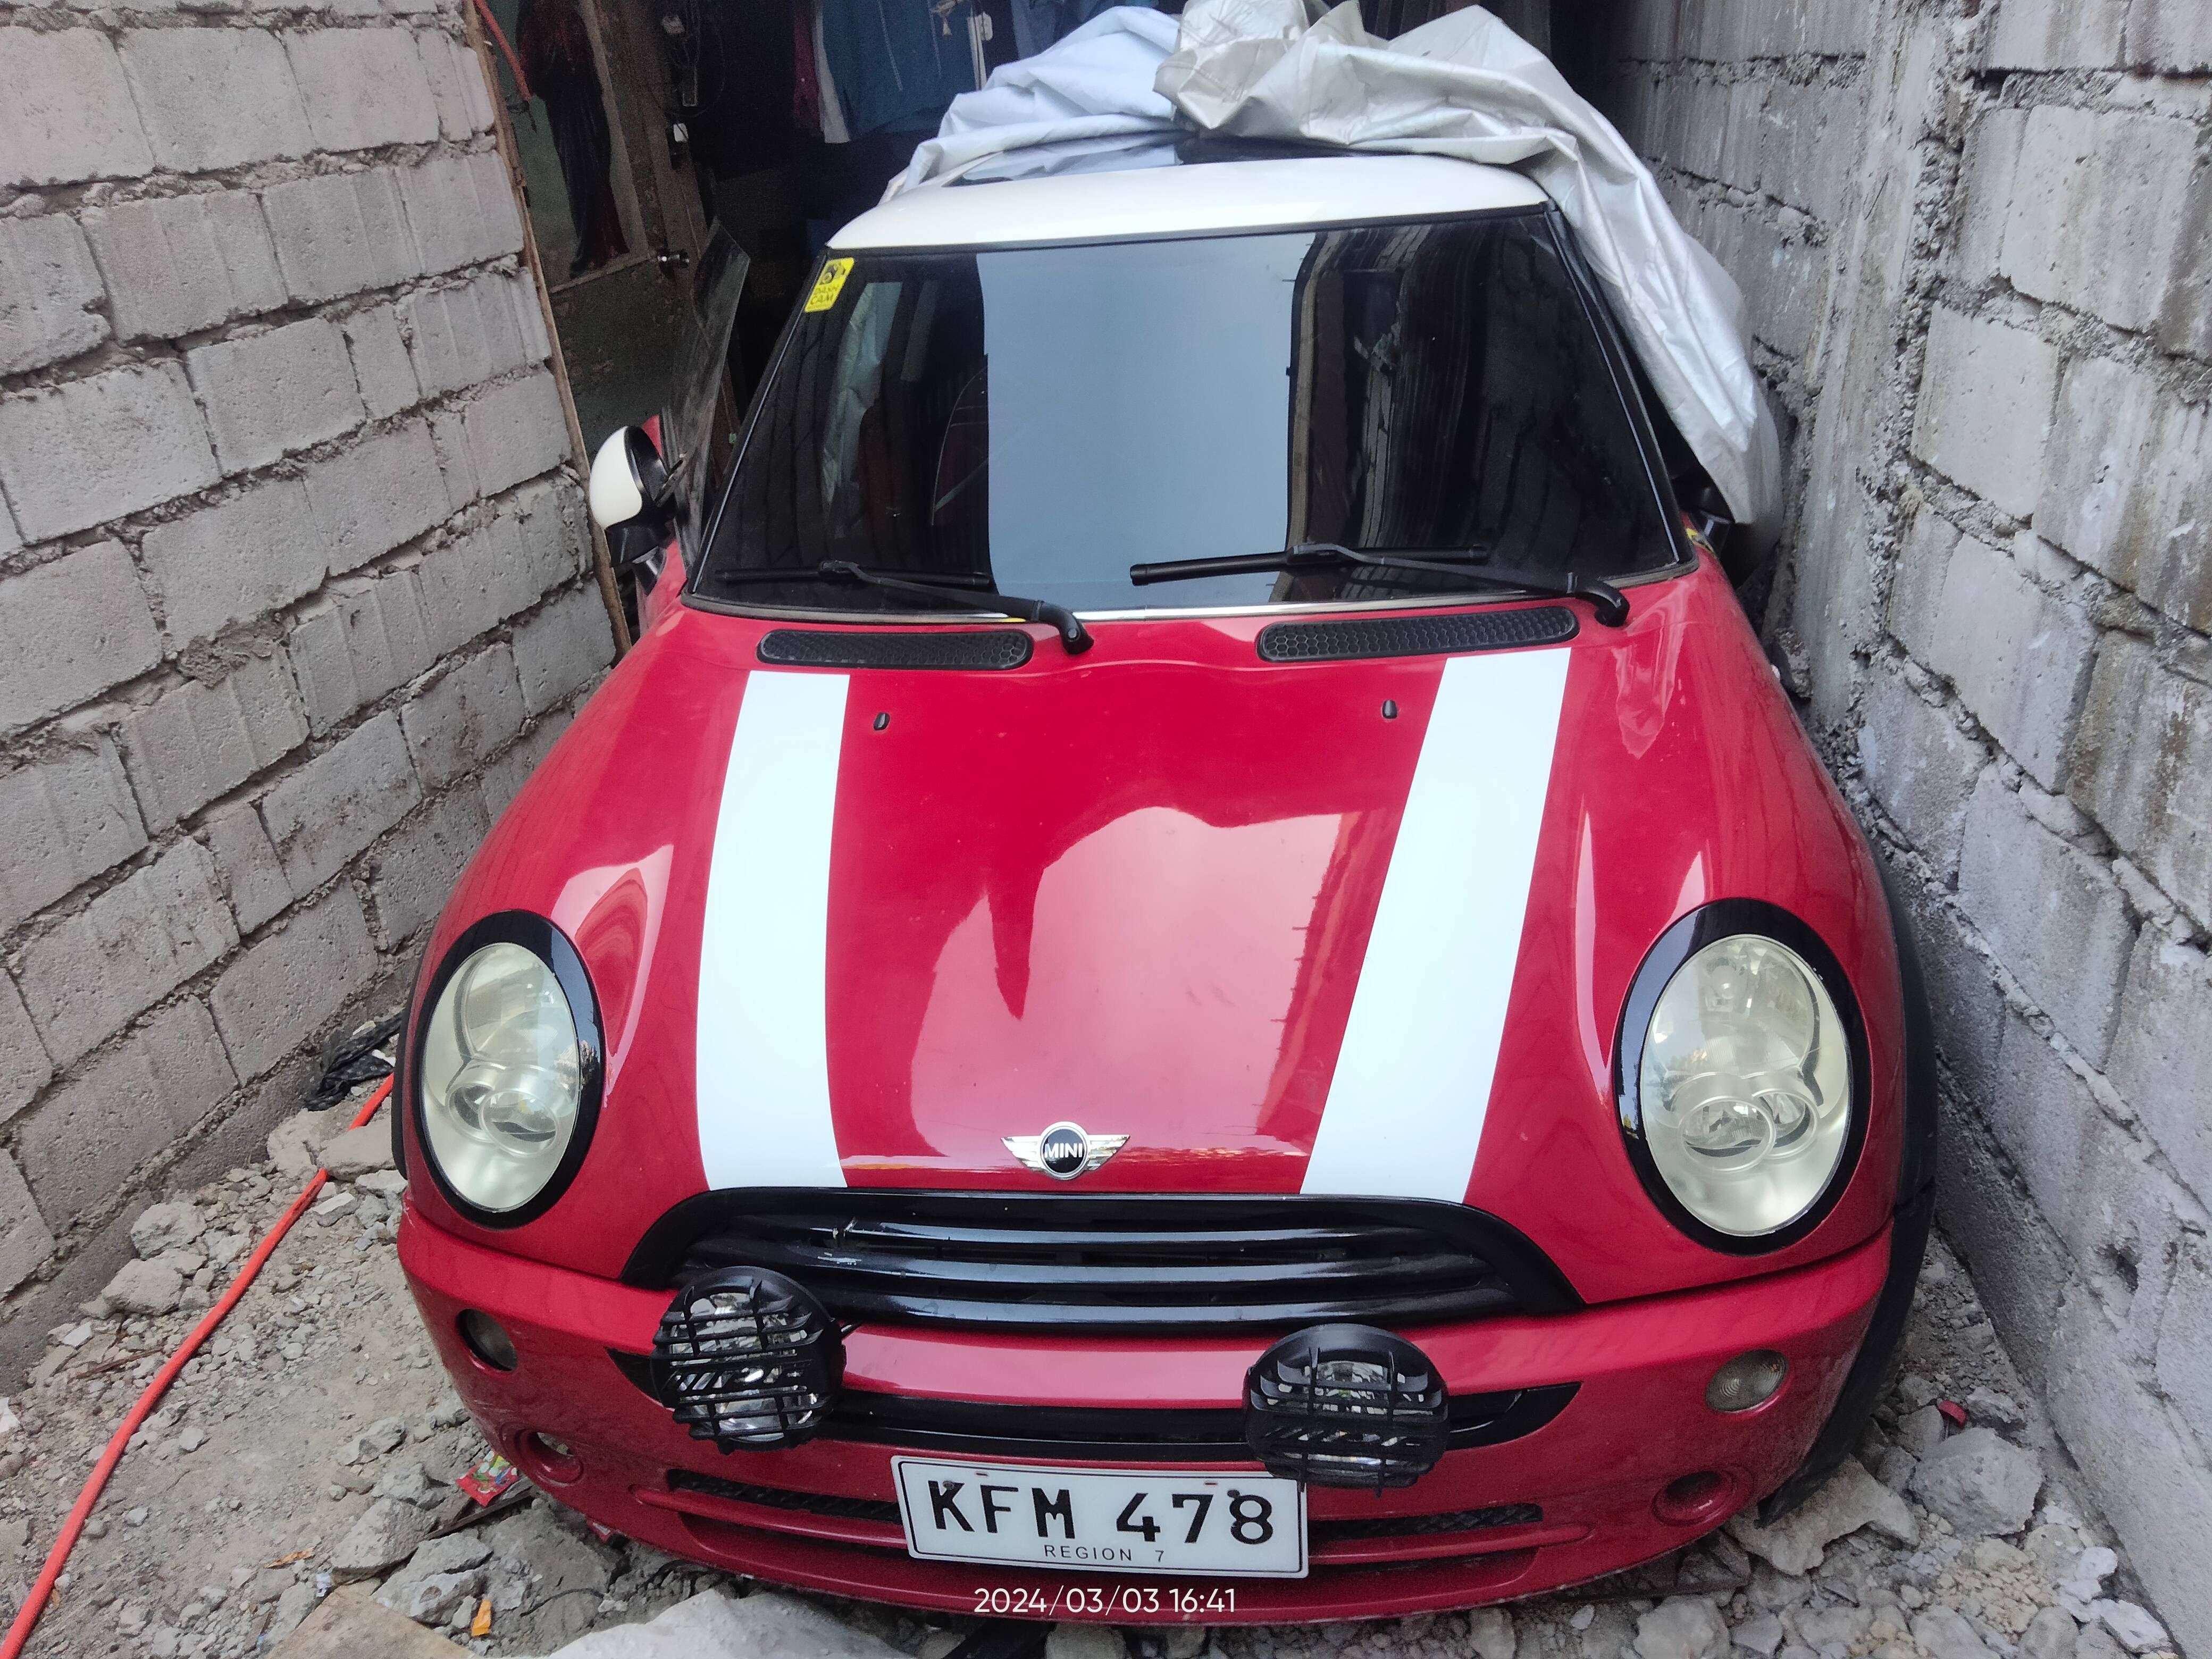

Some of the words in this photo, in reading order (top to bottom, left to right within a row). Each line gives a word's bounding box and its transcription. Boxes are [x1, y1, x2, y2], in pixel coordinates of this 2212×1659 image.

[1044, 1143, 1083, 1159] MINI
[928, 1480, 1075, 1539] KFM
[1117, 1493, 1273, 1545] 478
[1044, 1545, 1132, 1562] REGION
[1154, 1550, 1164, 1562] 7
